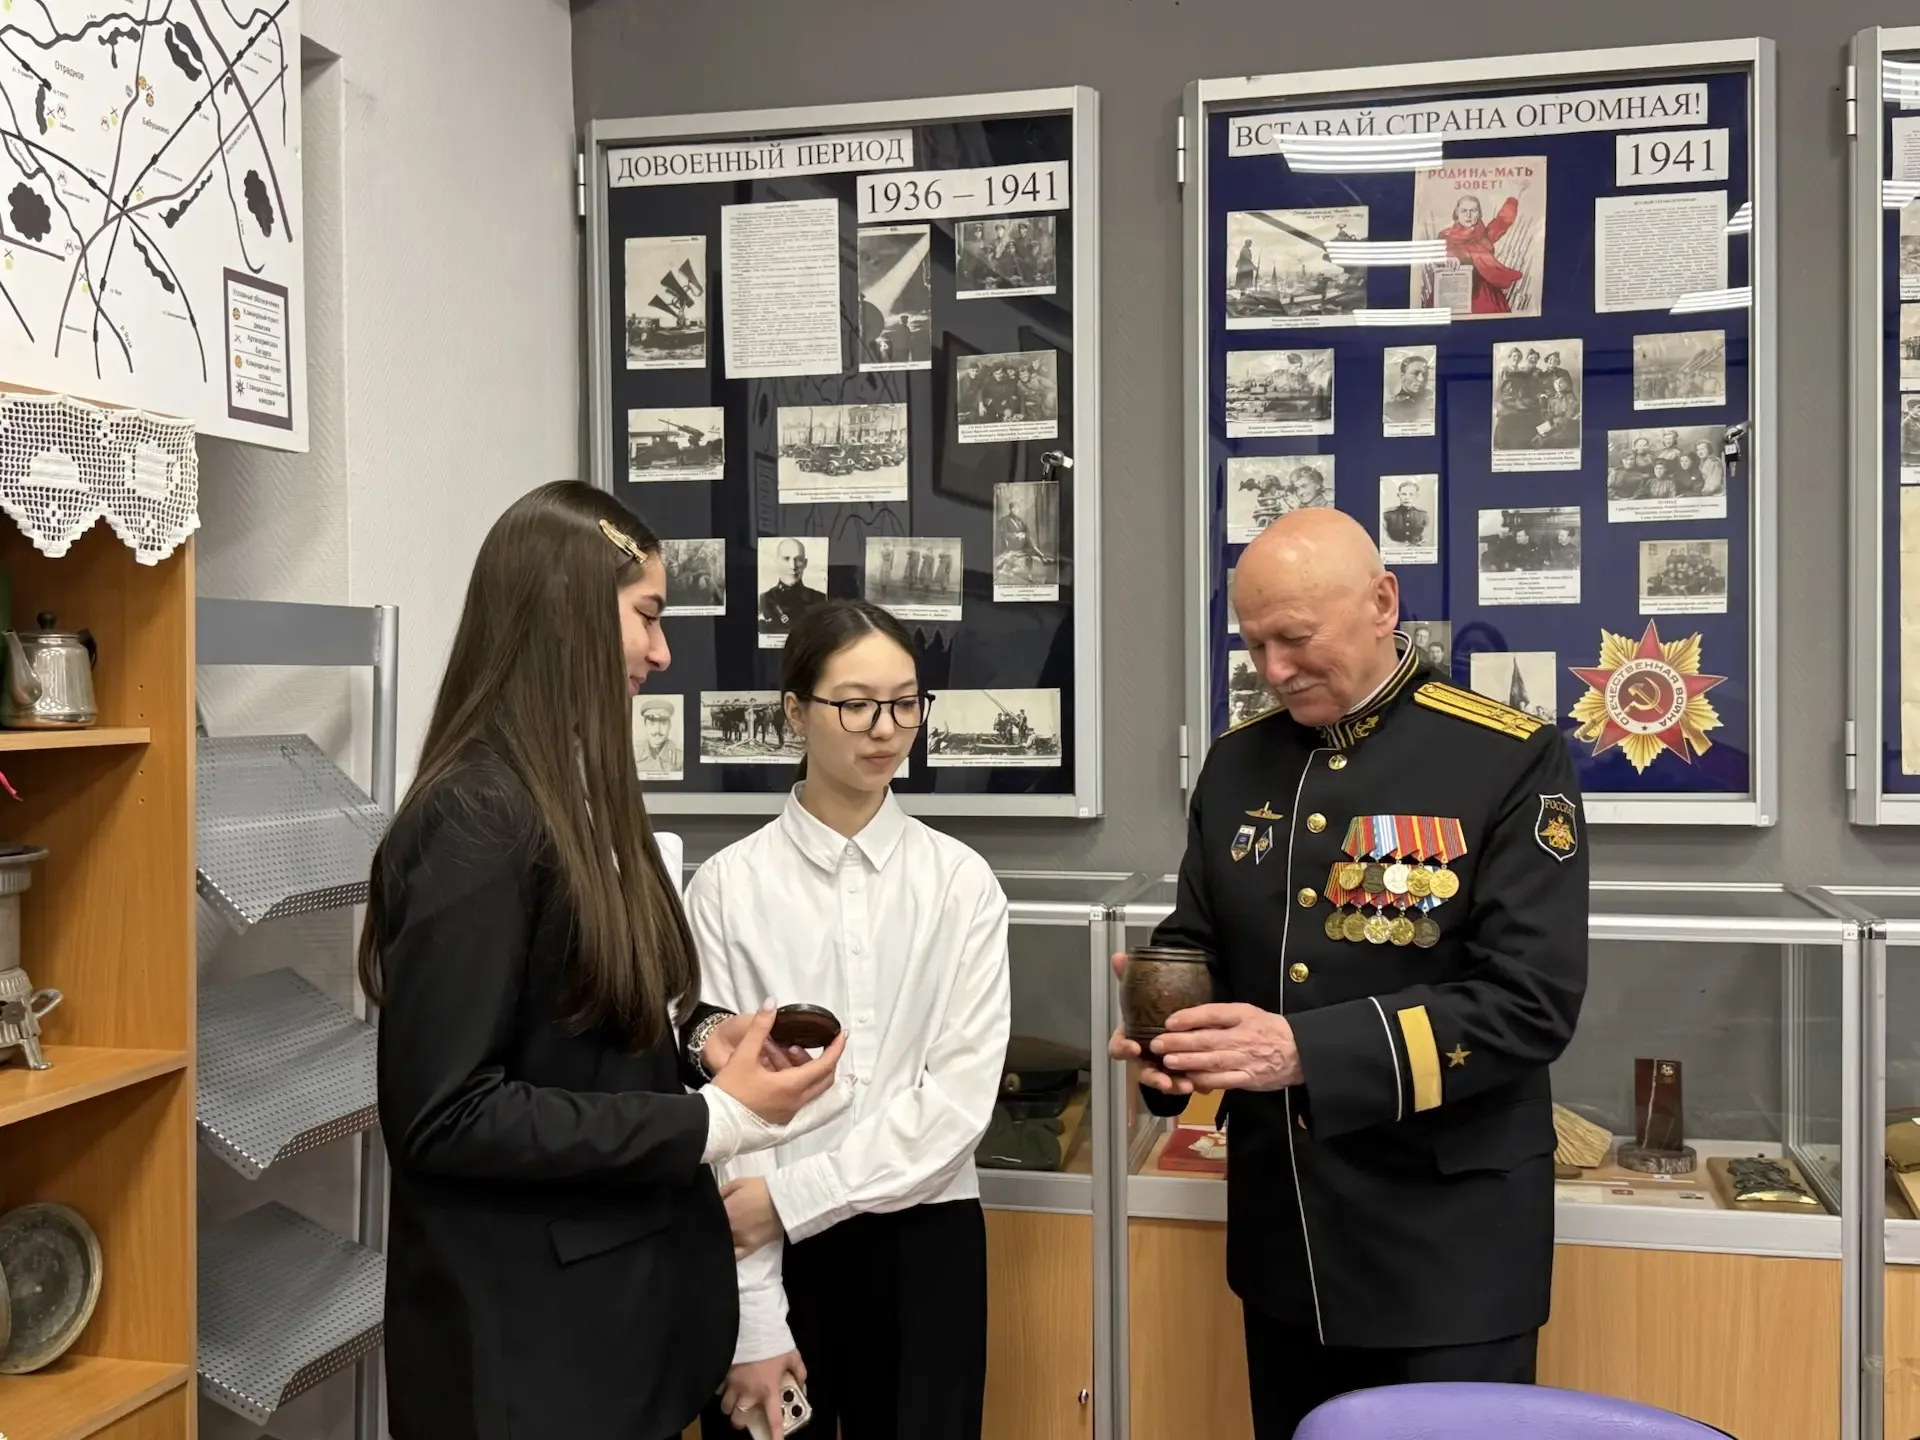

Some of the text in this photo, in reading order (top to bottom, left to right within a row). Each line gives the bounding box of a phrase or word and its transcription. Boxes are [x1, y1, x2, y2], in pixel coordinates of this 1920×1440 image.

[1387, 107, 1506, 136] СТРАНА
[1517, 93, 1700, 128] ОГРОМНАЯ!
[618, 139, 904, 181] ДОВОЕННЫЙ ПЕРИОД
[1428, 166, 1533, 180] РОДИНА-МАТЬ
[1630, 139, 1715, 176] 1941
[868, 179, 942, 214] 1936
[985, 171, 1057, 206] 1941
[1454, 180, 1503, 191] ЗОВЕТ!
[1608, 661, 1680, 726] ОТЕЧЕСТВЕННАЯ
